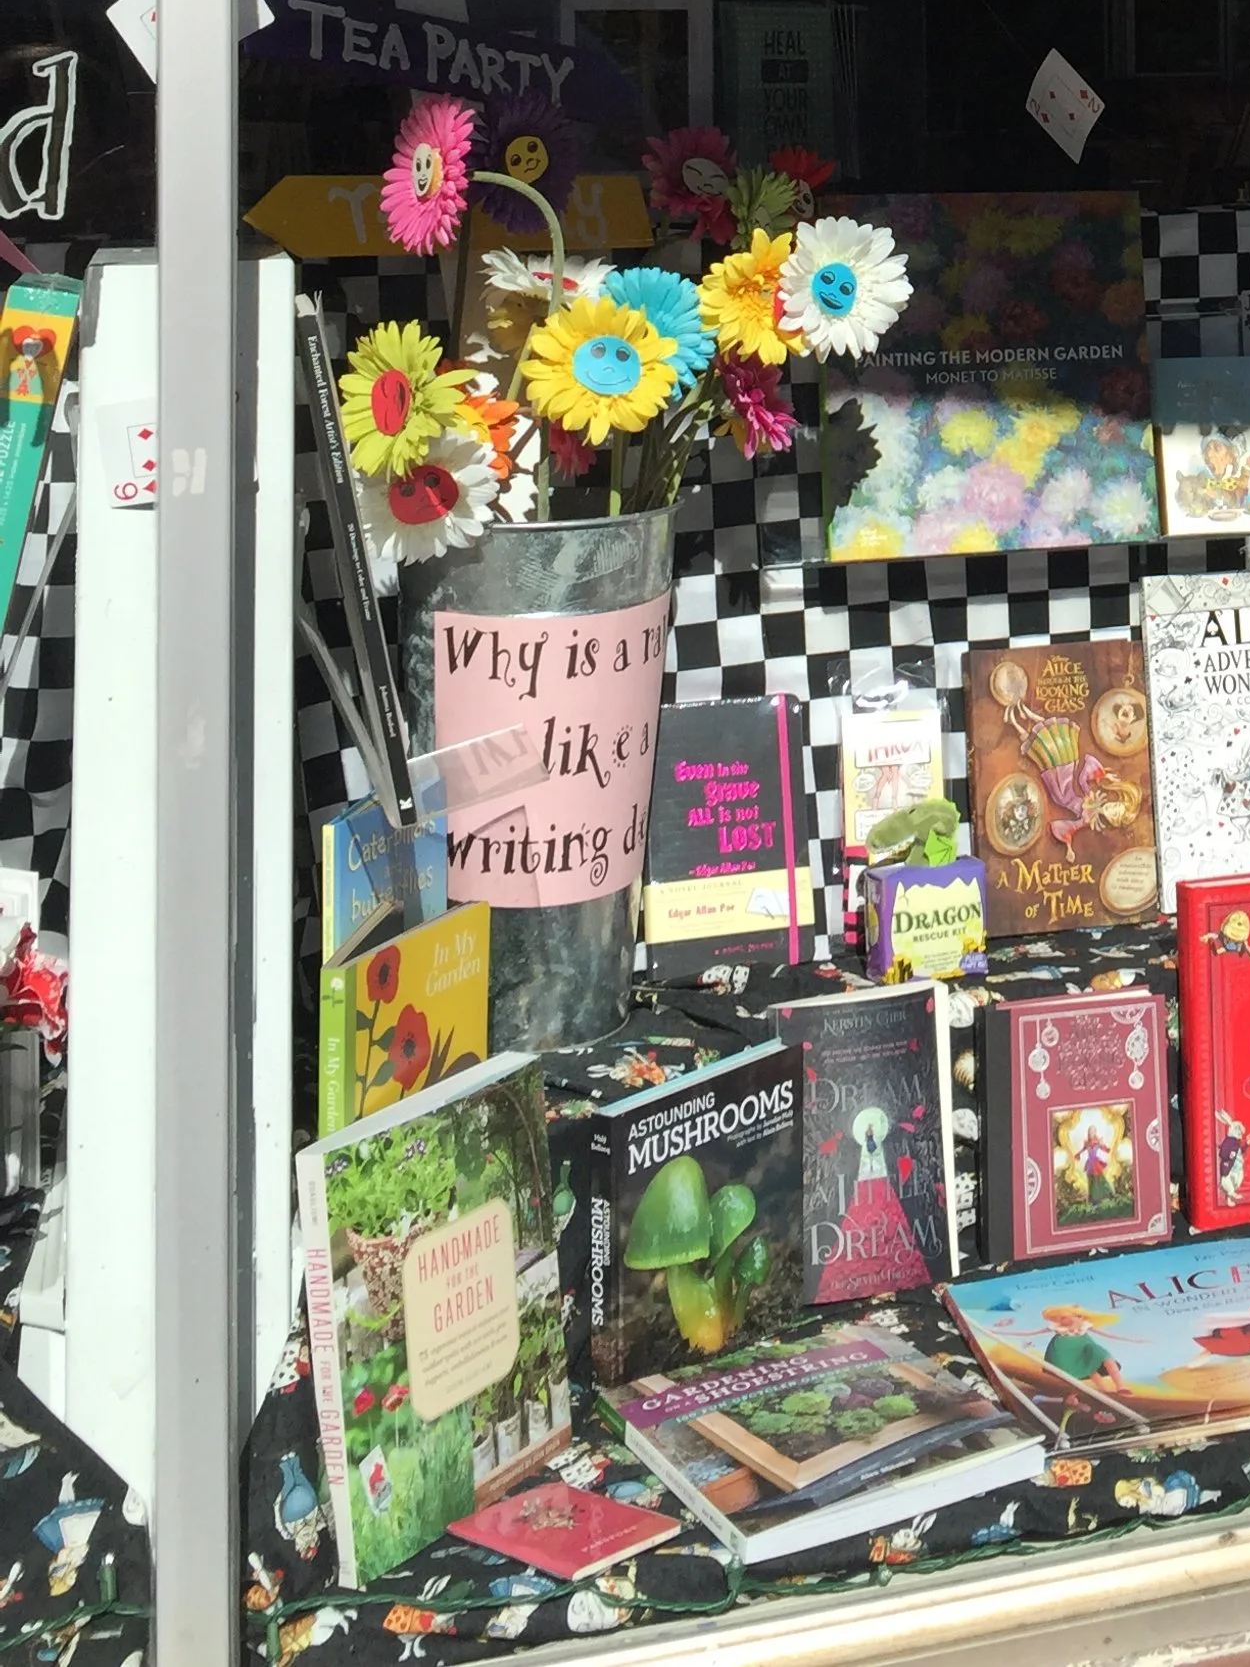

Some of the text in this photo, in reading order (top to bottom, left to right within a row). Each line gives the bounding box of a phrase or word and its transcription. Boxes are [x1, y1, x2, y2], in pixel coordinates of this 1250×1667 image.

[763, 30, 807, 55] HEAL
[421, 21, 577, 106] PARTY
[763, 87, 809, 113] YOUR
[854, 343, 1124, 369] PAINTING THE MODERN GARDEN
[925, 366, 1058, 386] MONET TO MATISSE
[305, 334, 347, 484] Enchanted Forest Artist's Edition
[442, 625, 632, 701] Why is a
[1041, 660, 1085, 678] ALICE
[1035, 682, 1091, 701] LOOKING
[1044, 696, 1086, 714] GLASS
[542, 715, 651, 789] like a
[673, 758, 750, 783] Even in the
[703, 779, 761, 808] grave
[687, 804, 760, 828] ALL is not
[446, 822, 613, 888] writing
[717, 820, 777, 854] LOST
[996, 870, 1010, 890] A
[667, 902, 736, 921] Edgar Allan Poe
[892, 901, 983, 936] DRAGON
[1024, 905, 1038, 920] OF
[433, 930, 477, 969] In My
[912, 926, 968, 944] RESCUE KIT
[425, 957, 482, 998] Garden
[876, 1010, 907, 1028] GIER
[325, 1036, 341, 1133] In My Garden
[809, 1072, 924, 1116] DREAM
[627, 1091, 716, 1142] ASTOUNDING
[627, 1079, 794, 1176] MUSHROOMS
[416, 1214, 502, 1285] HANDMADE
[602, 1198, 611, 1267] ASTOUNDING
[809, 1214, 943, 1266] DREAM
[590, 1196, 605, 1328] MUSHROOMS
[305, 1248, 335, 1354] HANDMADE
[433, 1275, 496, 1335] GARDEN
[319, 1359, 332, 1380] FOR
[641, 1354, 809, 1412] GARDENING
[695, 1350, 869, 1404] SHOESTRING
[321, 1384, 334, 1403] THE
[320, 1409, 345, 1487] GARDEN
